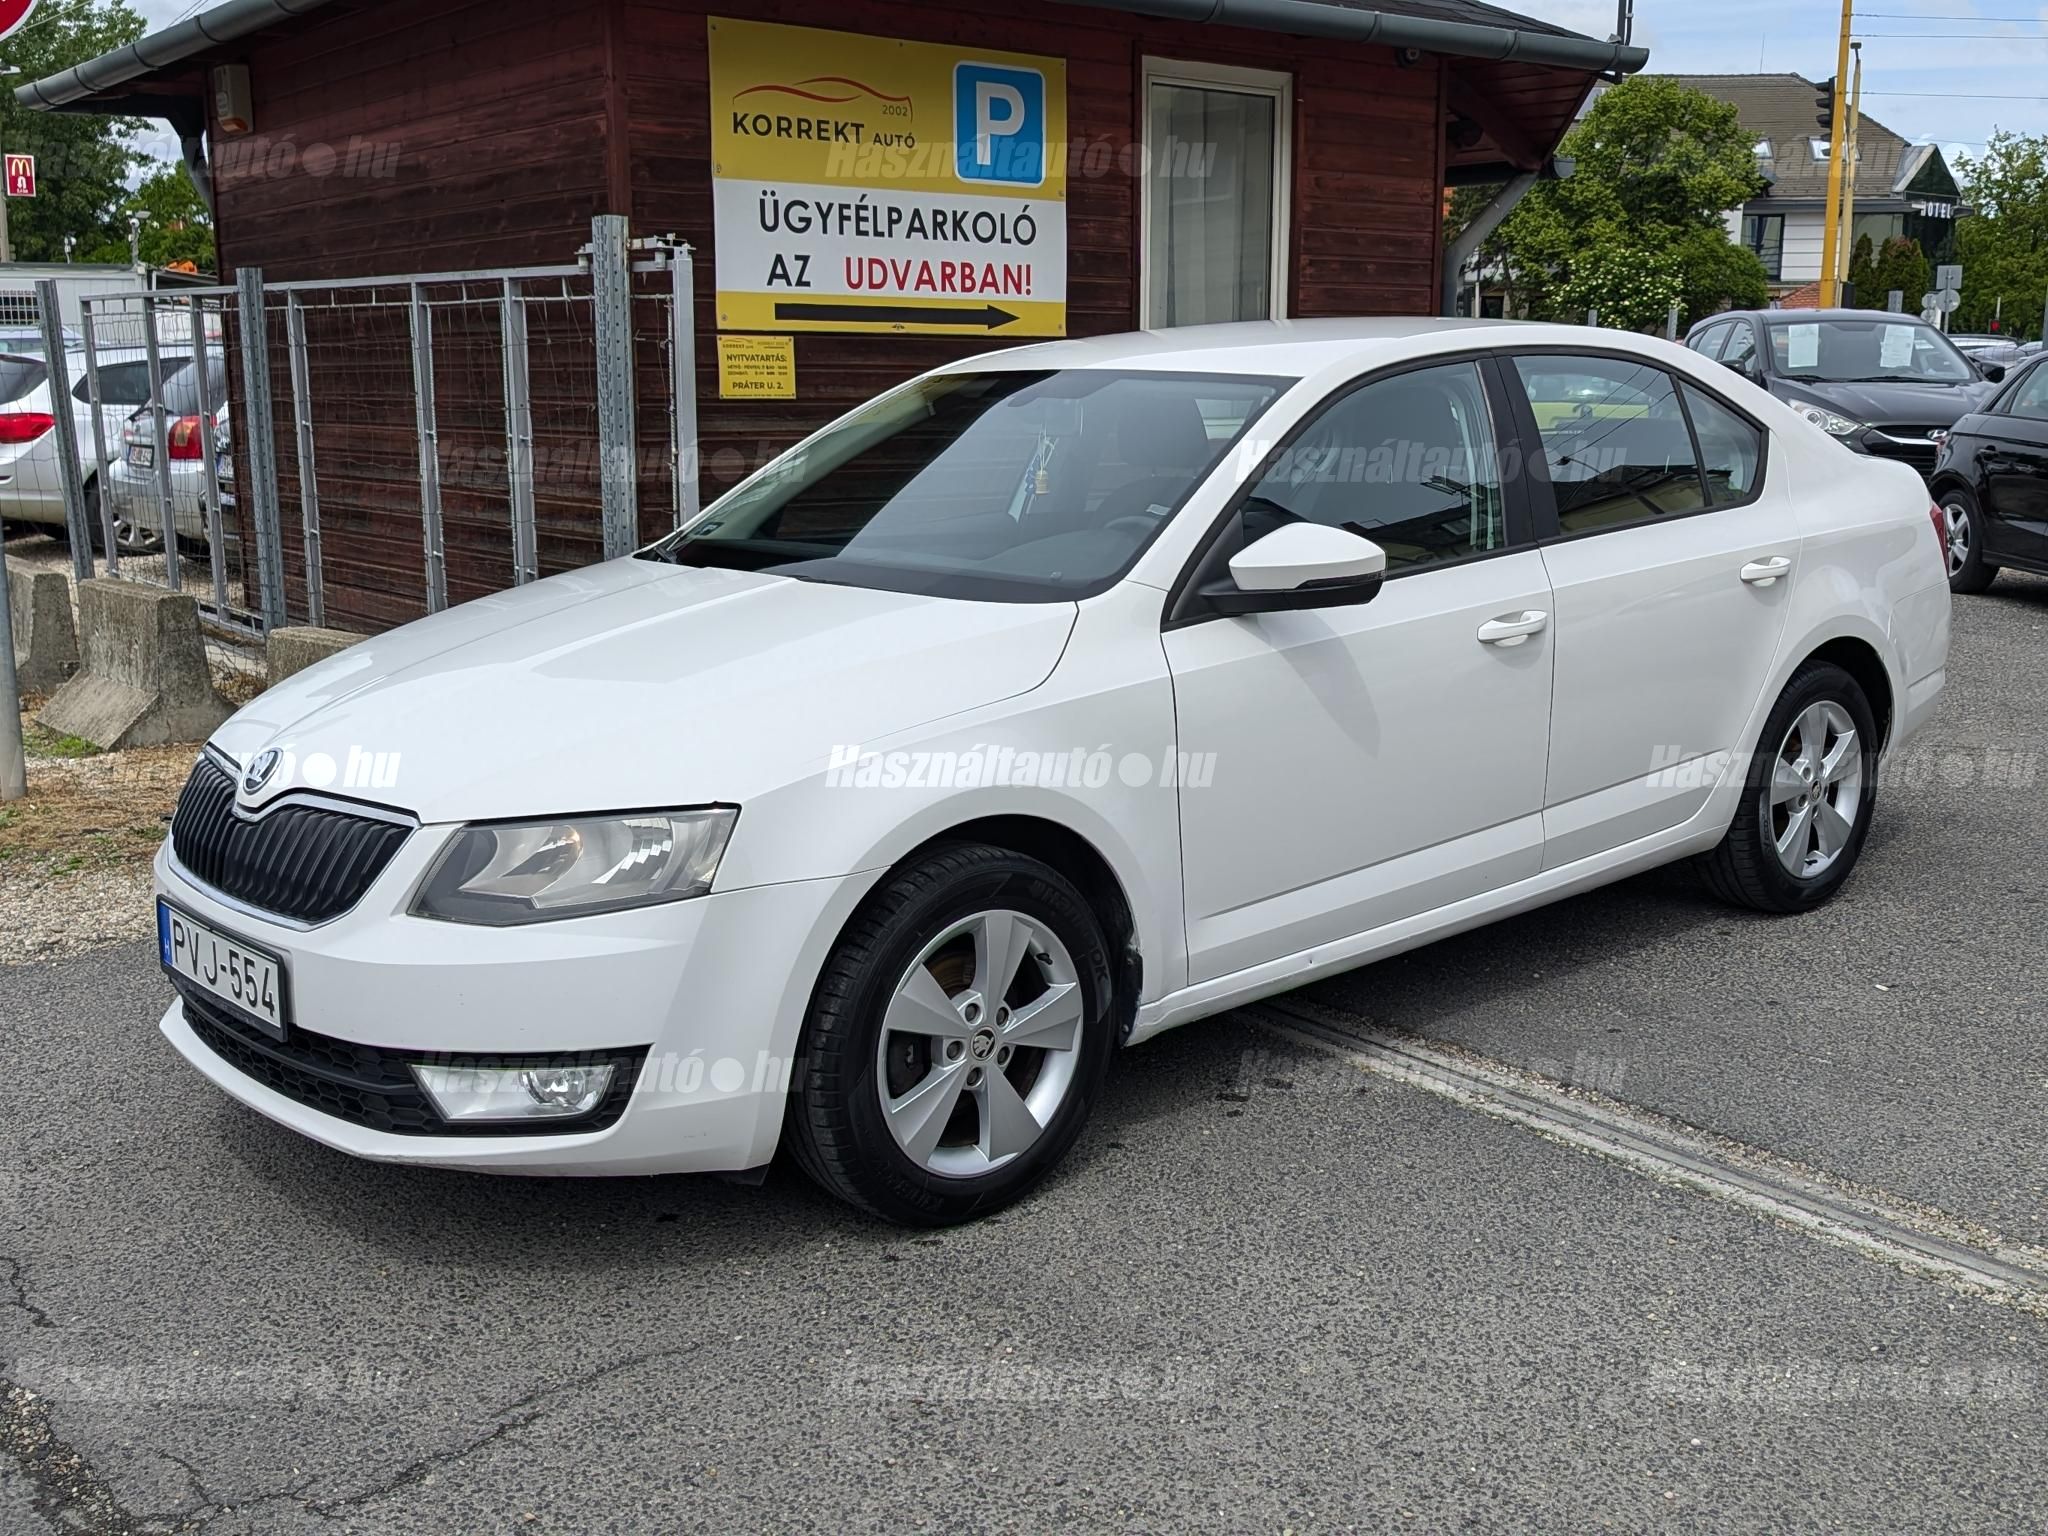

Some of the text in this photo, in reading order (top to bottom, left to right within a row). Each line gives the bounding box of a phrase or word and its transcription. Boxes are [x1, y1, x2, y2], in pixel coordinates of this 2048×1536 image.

[732, 112, 915, 149] KORREKT AUTÓ
[882, 104, 908, 117] 2002
[976, 81, 1025, 166] P
[759, 190, 1037, 246] ÜGYFÉLPARKOLÓ
[766, 253, 1032, 296] AZ UDVARBAN!
[732, 380, 765, 390] PRÁTER
[172, 917, 275, 1018] PVJ-554
